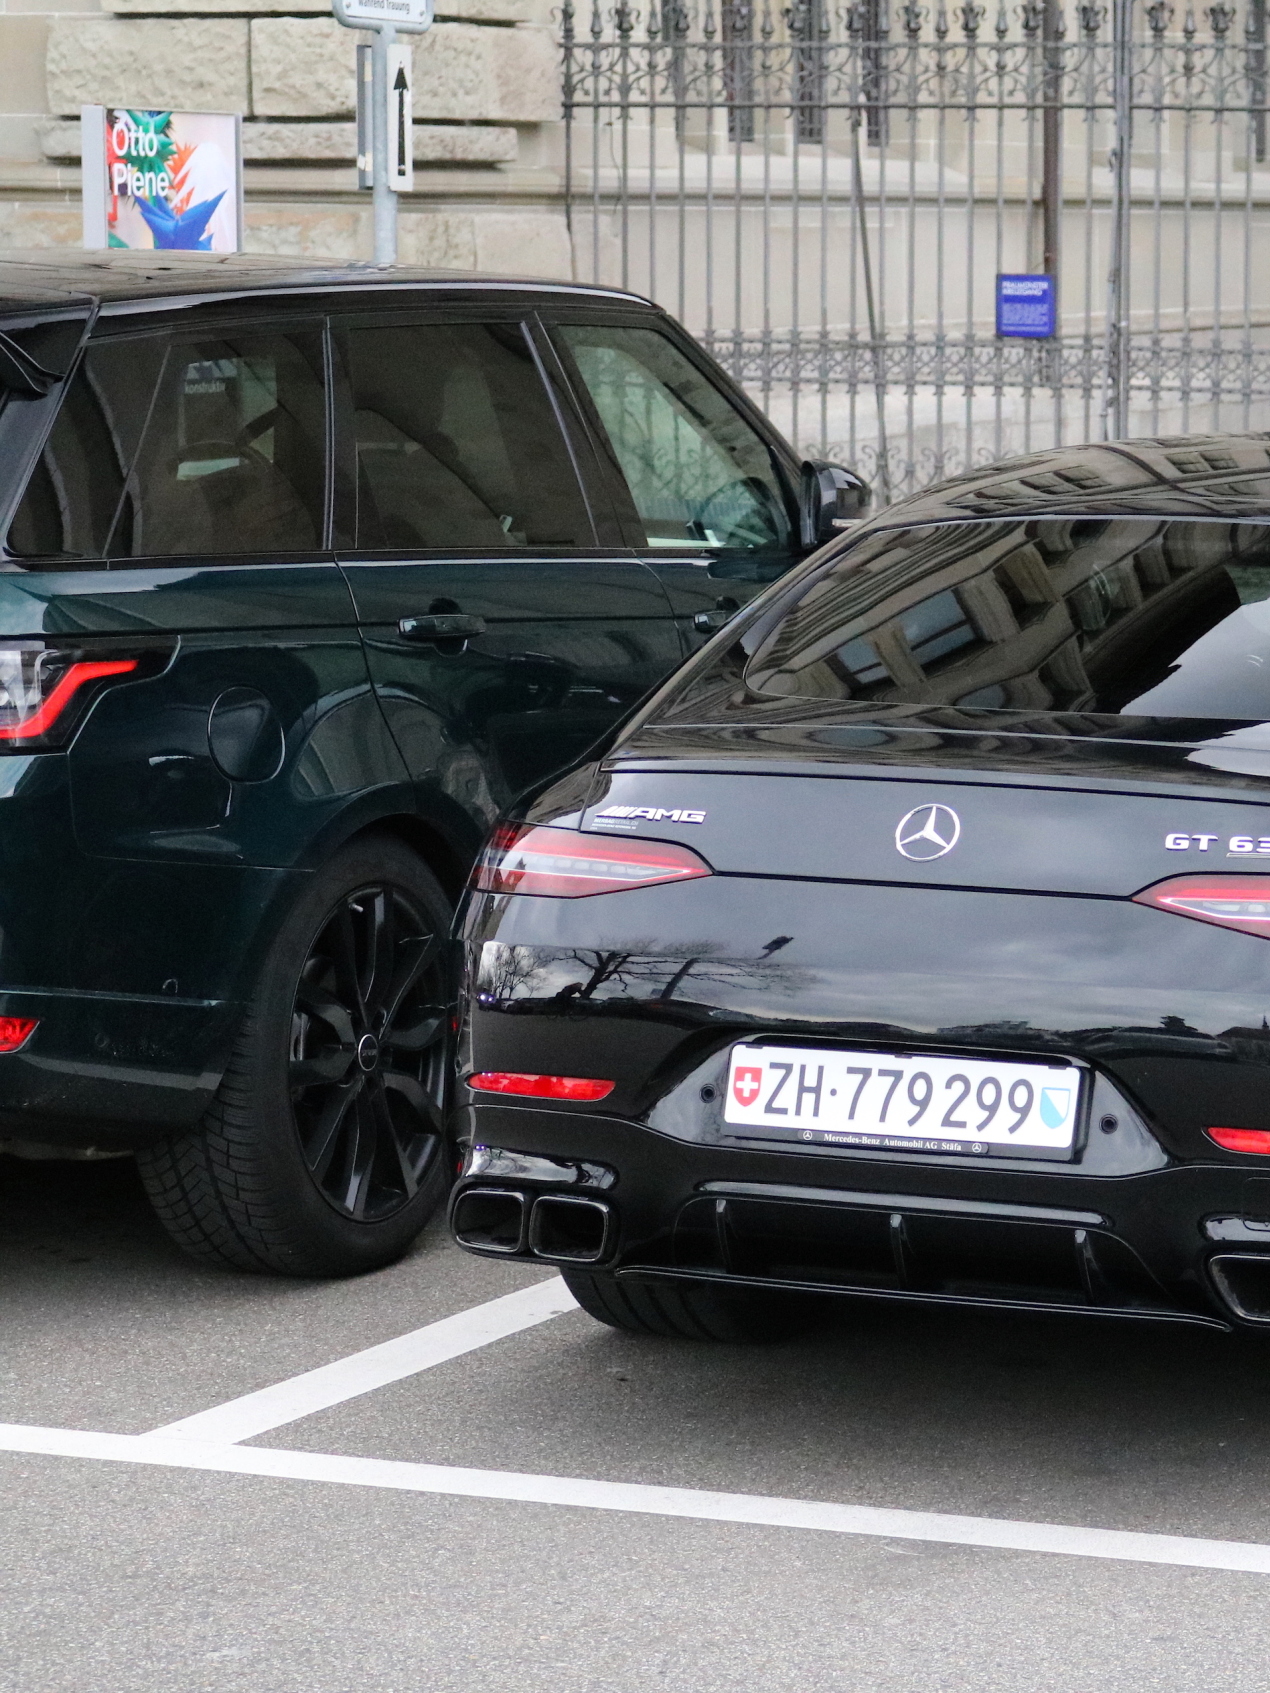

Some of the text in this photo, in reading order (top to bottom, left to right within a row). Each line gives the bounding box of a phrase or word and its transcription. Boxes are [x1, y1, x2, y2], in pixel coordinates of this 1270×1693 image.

[112, 122, 158, 157] Otto
[113, 162, 169, 197] Piene
[627, 806, 707, 824] AMG
[1165, 833, 1218, 851] GT
[823, 1133, 962, 1151] Mercedes-Benz Automobil AG Stäfa
